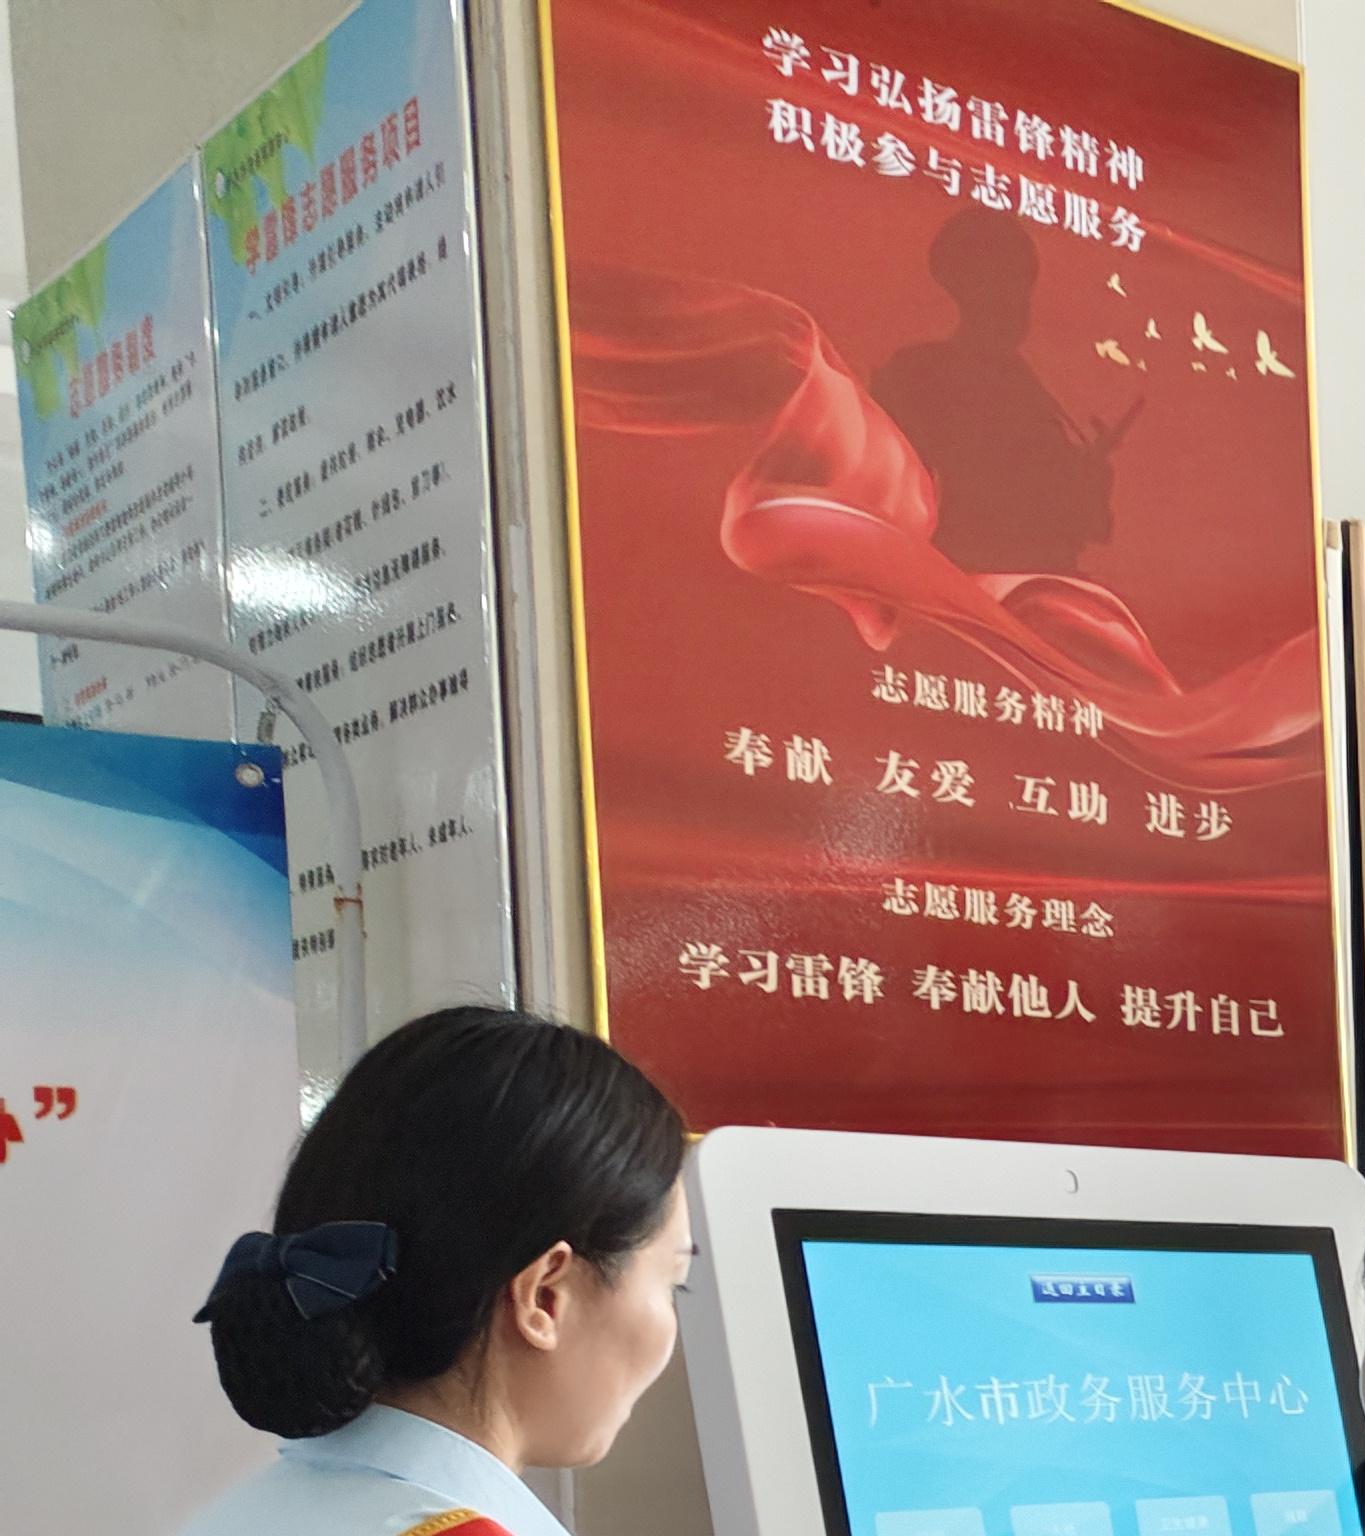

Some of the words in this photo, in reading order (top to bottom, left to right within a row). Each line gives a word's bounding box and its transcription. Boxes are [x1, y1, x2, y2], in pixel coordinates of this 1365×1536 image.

[762, 25, 1147, 192] 学习弘扬雷锋精神
[765, 95, 1147, 253] 积极参与志愿服务
[871, 665, 1105, 740] 志愿服务精神
[724, 726, 834, 787] 奉献
[876, 751, 975, 809] 友爱
[1014, 774, 1109, 826] 互助
[1146, 792, 1233, 843] 进步
[881, 878, 1115, 940] 志愿服务理念
[679, 942, 885, 1004] 学习雷锋
[912, 964, 1096, 1026] 奉献他人
[1121, 985, 1286, 1039] 提升自己
[866, 1373, 1310, 1428] 广水市政务服务中心
